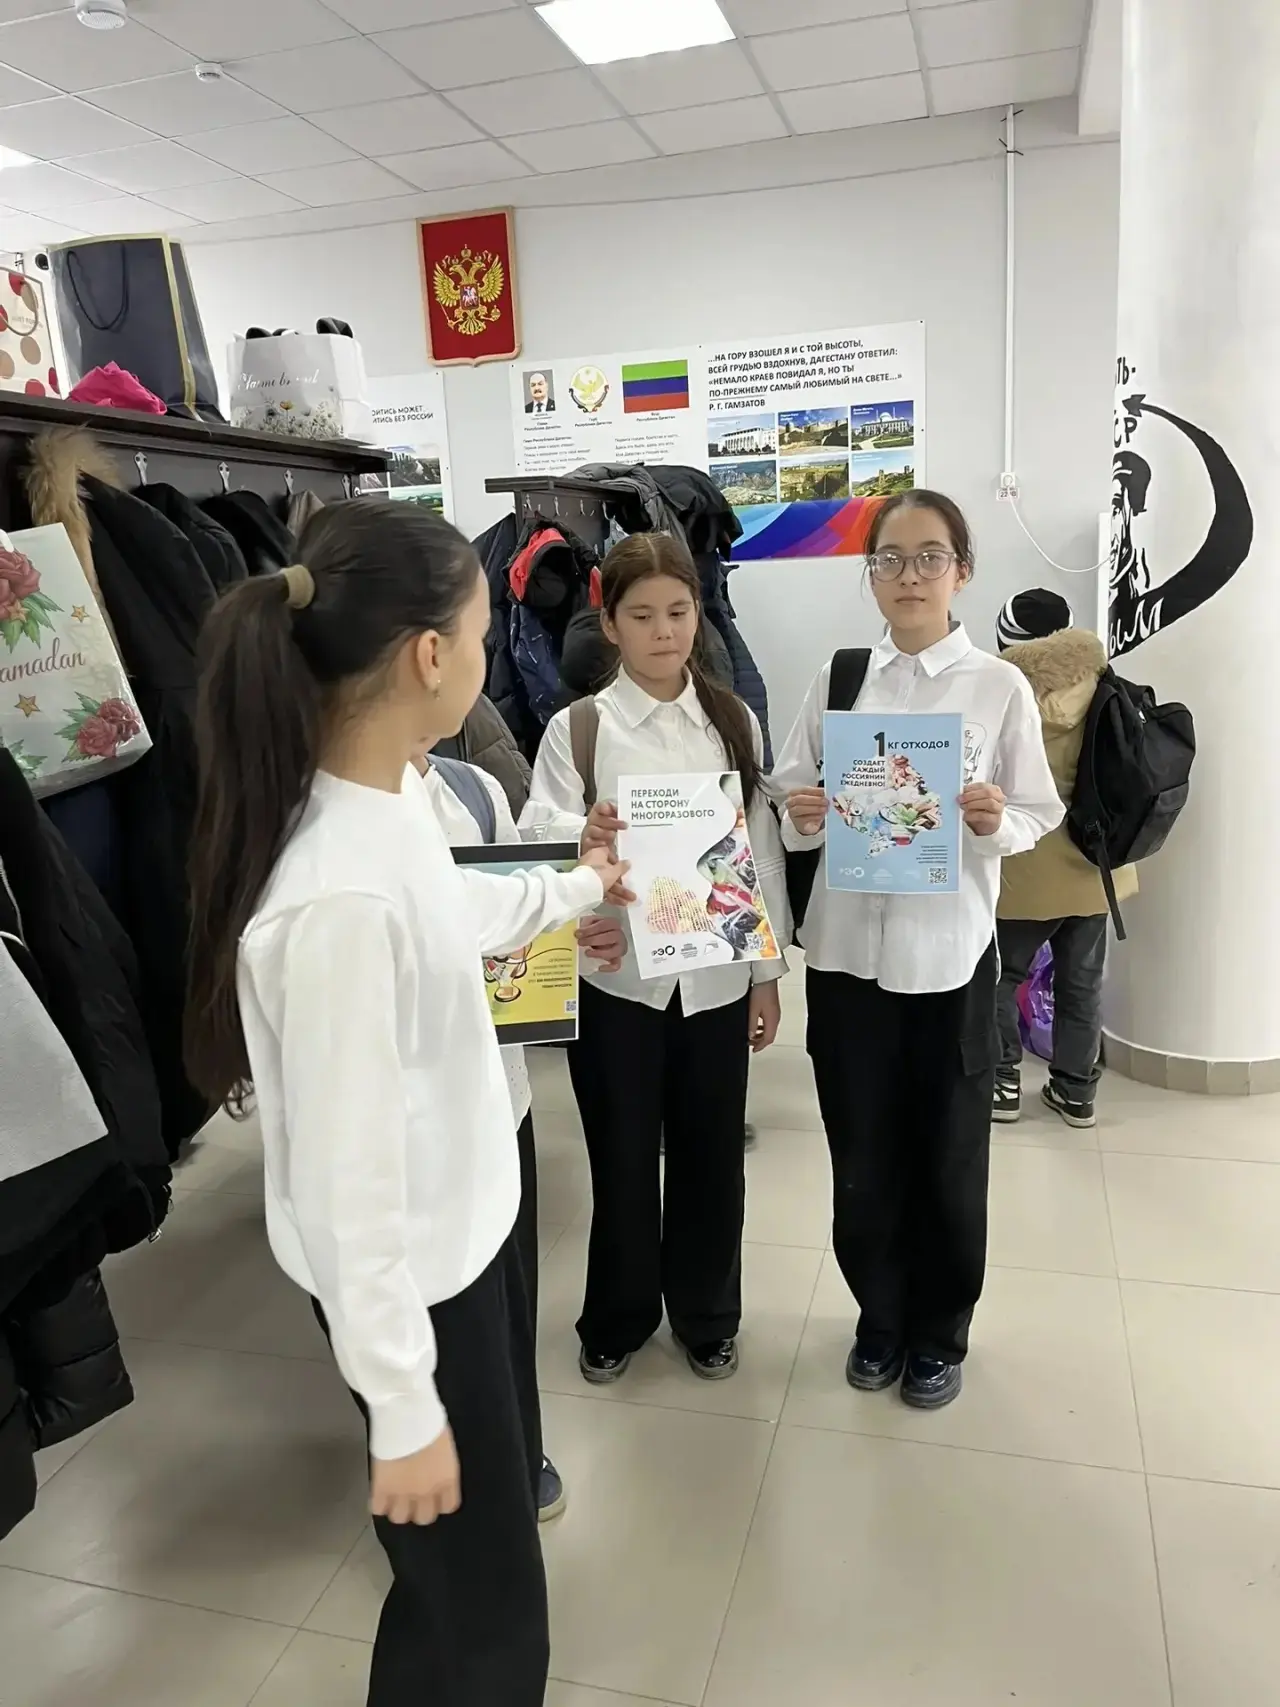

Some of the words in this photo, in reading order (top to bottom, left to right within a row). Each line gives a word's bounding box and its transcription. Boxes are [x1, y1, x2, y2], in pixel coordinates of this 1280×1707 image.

[728, 351, 747, 360] ГОРУ
[749, 348, 783, 358] ВЗОШЕЛ
[784, 347, 790, 355] Я
[791, 346, 798, 354] И
[806, 342, 823, 352] ТОЙ
[825, 340, 863, 351] ВЫСОТЫ,
[708, 364, 728, 374] ВСЕЙ
[729, 362, 762, 372] ГРУДЬЮ
[763, 358, 808, 369] ВЗДОХНУВ,
[809, 352, 855, 366] ДАГЕСТАНУ
[857, 348, 898, 359] ОТВЕТИЛ:
[708, 375, 748, 385] «НЕМАЛО
[749, 372, 774, 382] КРАЕВ
[776, 368, 816, 379] ПОВИДАЛ
[818, 367, 826, 376] Я,
[827, 366, 840, 374] НО
[842, 365, 855, 373] ТЫ
[709, 385, 768, 397] ПО-ПРЕЖНЕМУ
[769, 381, 801, 392] САМЫЙ
[802, 376, 850, 389] ЛЮБИМЫЙ
[851, 376, 863, 384] НА
[865, 373, 902, 383] СВЕТЕ...»
[709, 403, 716, 411] Р.
[724, 399, 766, 409] ГАМЗАТОВ
[873, 732, 885, 757] 1
[888, 741, 900, 749] КГ
[901, 740, 950, 750] ОТХОДОВ
[631, 789, 679, 798] ПЕРЕХОДИ
[631, 801, 644, 809] НА
[645, 799, 690, 808] СТОРОНУ
[631, 809, 715, 820] МНОГОРАЗОВОГО
